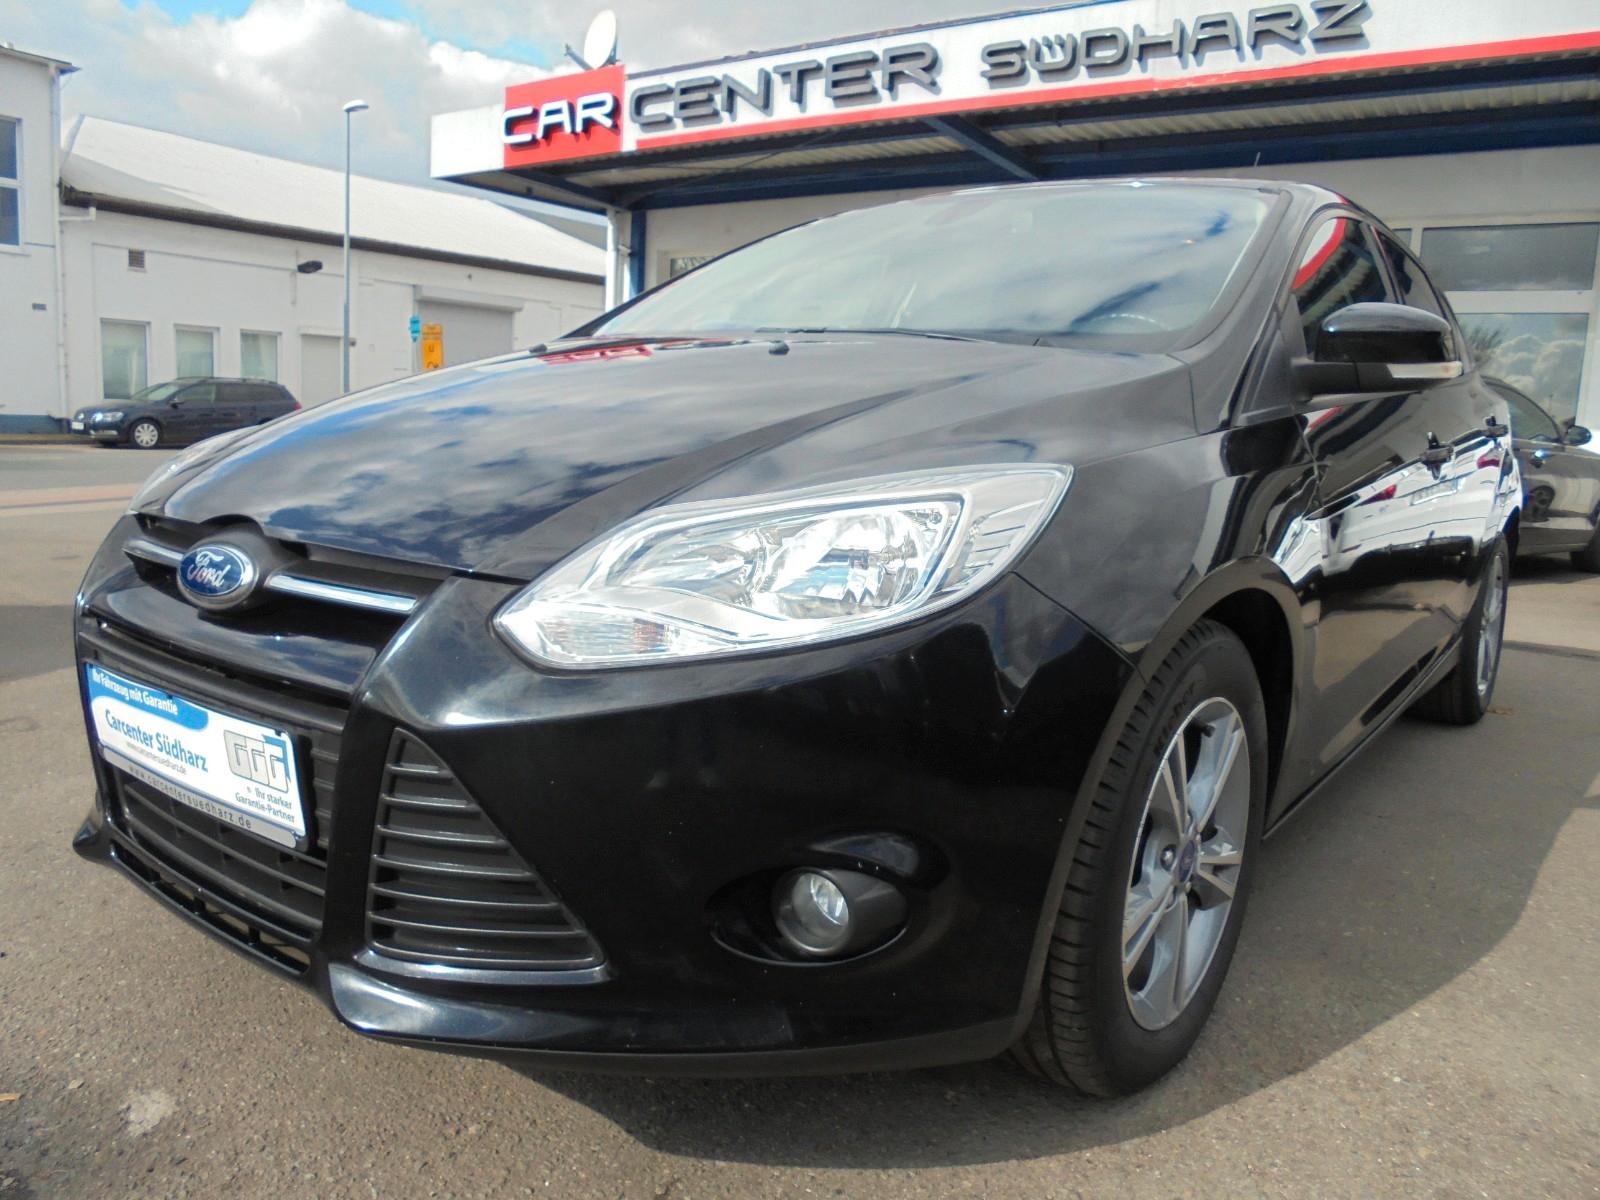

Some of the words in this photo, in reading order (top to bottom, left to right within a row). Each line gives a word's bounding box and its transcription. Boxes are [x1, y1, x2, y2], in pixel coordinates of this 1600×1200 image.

[502, 93, 618, 145] CAR
[630, 42, 942, 130] CENTER
[981, 0, 1367, 80] SÜDHARZ
[187, 551, 232, 587] Ford
[129, 687, 143, 702] mit
[142, 691, 178, 715] Garantie
[105, 708, 153, 748] Carcenter
[151, 732, 208, 772] Südharz
[235, 792, 295, 823] Garantie-Partner
